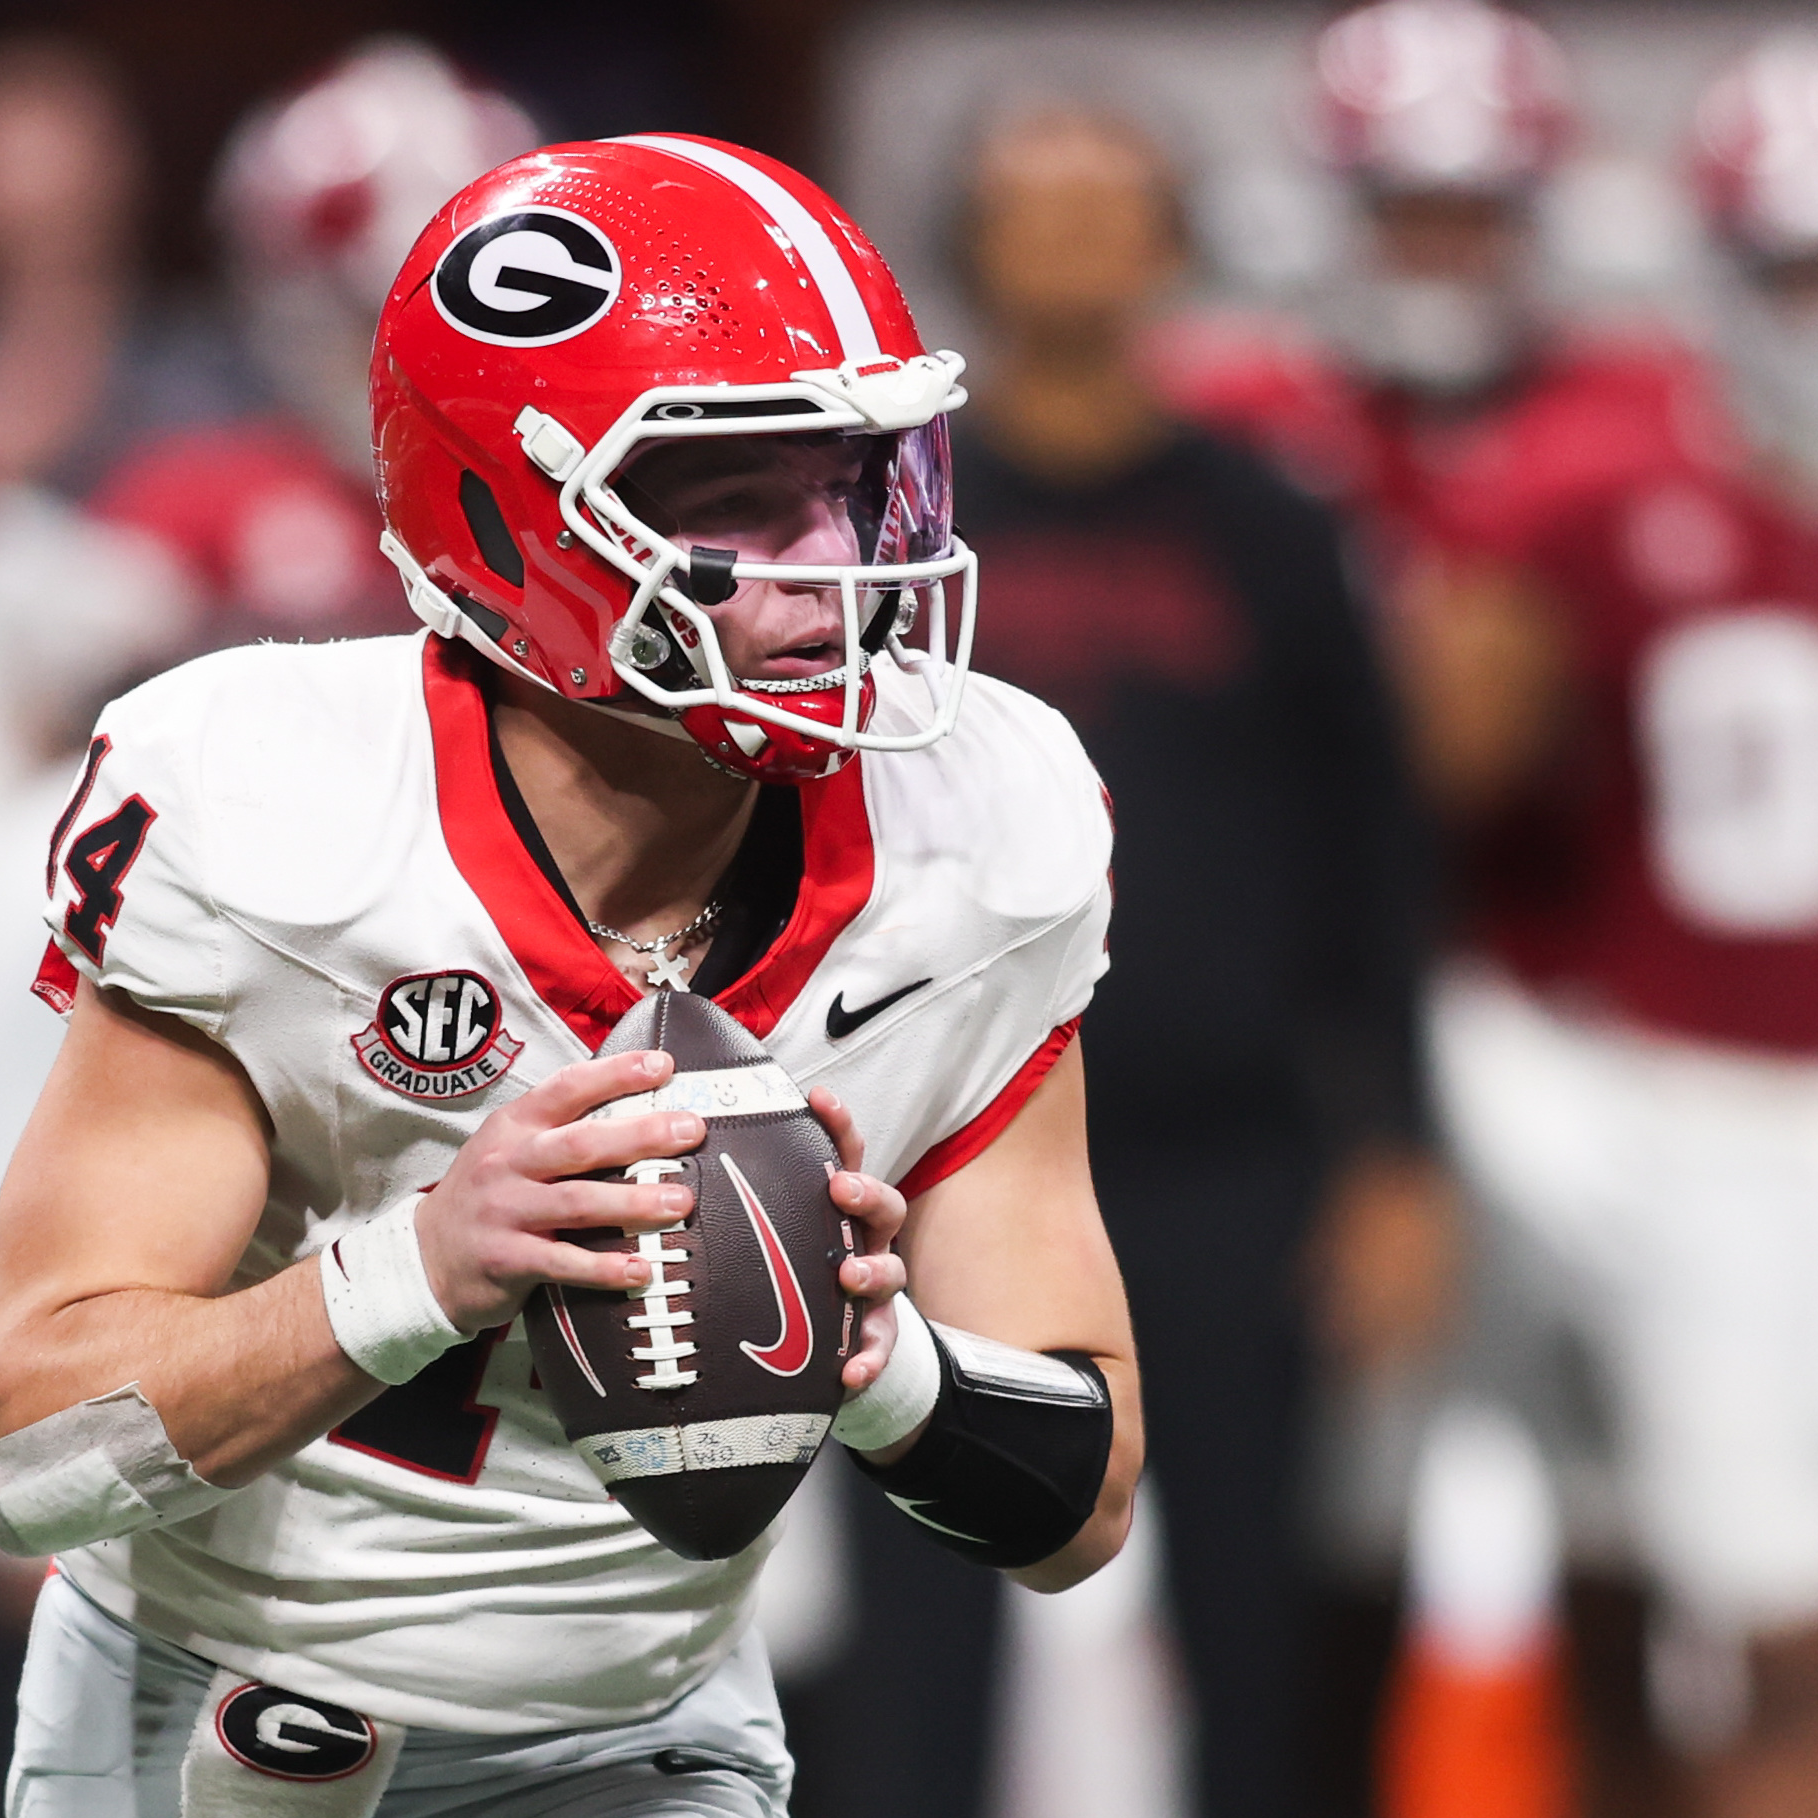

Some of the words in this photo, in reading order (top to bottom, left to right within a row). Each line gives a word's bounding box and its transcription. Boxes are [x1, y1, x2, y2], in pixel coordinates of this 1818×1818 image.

[435, 212, 613, 338] G
[47, 733, 158, 968] 14
[389, 974, 491, 1062] SEC
[370, 1049, 499, 1096] GRADUATE
[221, 1684, 374, 1778] G
